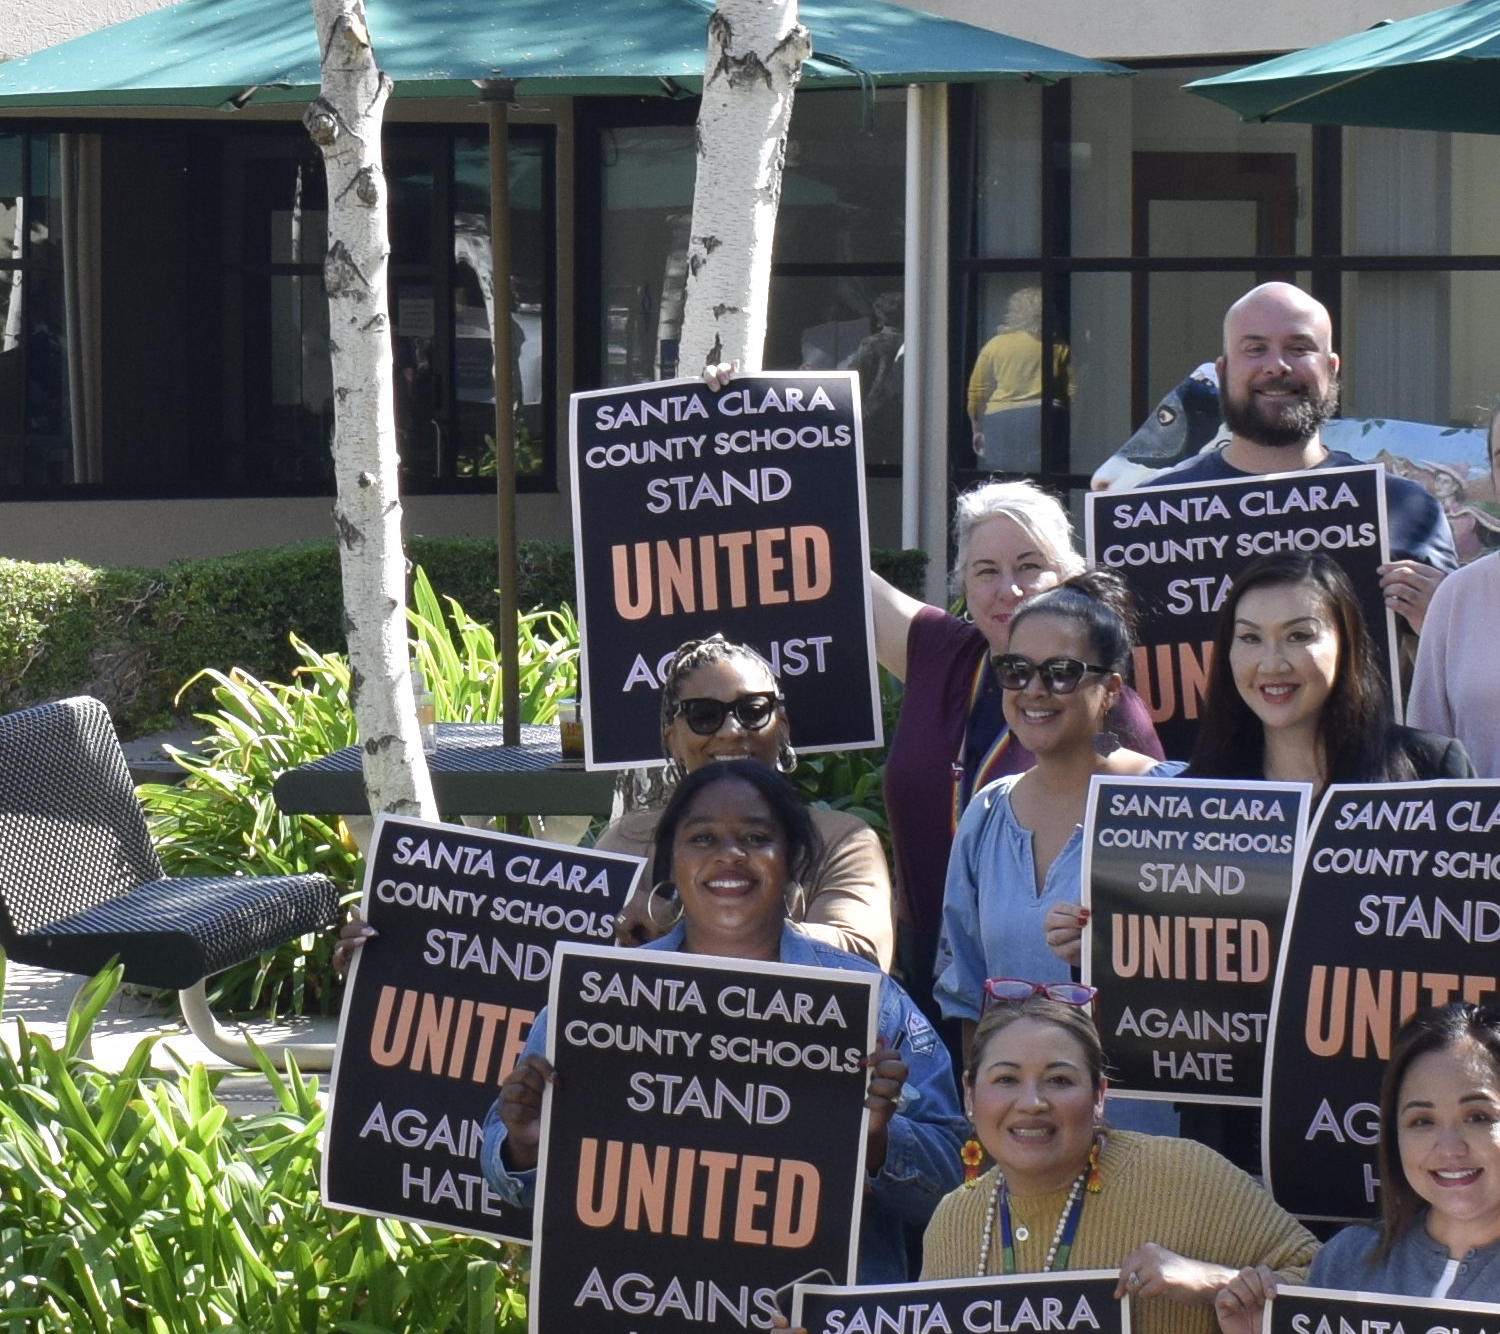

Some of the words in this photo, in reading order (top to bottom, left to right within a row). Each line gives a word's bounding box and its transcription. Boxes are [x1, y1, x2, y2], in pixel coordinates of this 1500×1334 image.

[596, 394, 708, 430] SANTA
[717, 386, 835, 416] CLARA
[586, 434, 706, 468] COUNTY
[714, 425, 851, 455] SCHOOLS
[647, 467, 792, 513] STAND
[1113, 495, 1231, 529] SANTA
[1239, 483, 1359, 516] CLARA
[1103, 535, 1228, 567] COUNTY
[1236, 523, 1376, 556] SCHOOLS
[612, 526, 832, 621] UNITED
[1110, 794, 1193, 819] SANTA
[1200, 796, 1284, 822] CLARA
[1335, 800, 1436, 832] SANTA
[1098, 829, 1189, 850] COUNTY
[1193, 831, 1292, 854] SCHOOLS
[1313, 847, 1428, 876] COUNTY
[393, 837, 495, 879] SANTA
[505, 856, 610, 897] CLARA
[1138, 863, 1245, 896] STAND
[377, 879, 484, 917] COUNTY
[490, 898, 613, 938] SCHOOLS
[424, 929, 550, 982] STAND
[1111, 913, 1269, 983] UNITED
[580, 971, 706, 1014] SANTA
[717, 985, 847, 1028] CLARA
[565, 1020, 701, 1057] COUNTY
[710, 1036, 861, 1073] SCHOOLS
[1115, 1007, 1268, 1043] AGAINST
[1153, 1051, 1233, 1083] HATE
[627, 1072, 790, 1125] STAND
[576, 1137, 820, 1249] UNITED
[963, 1295, 1099, 1332] CLARA
